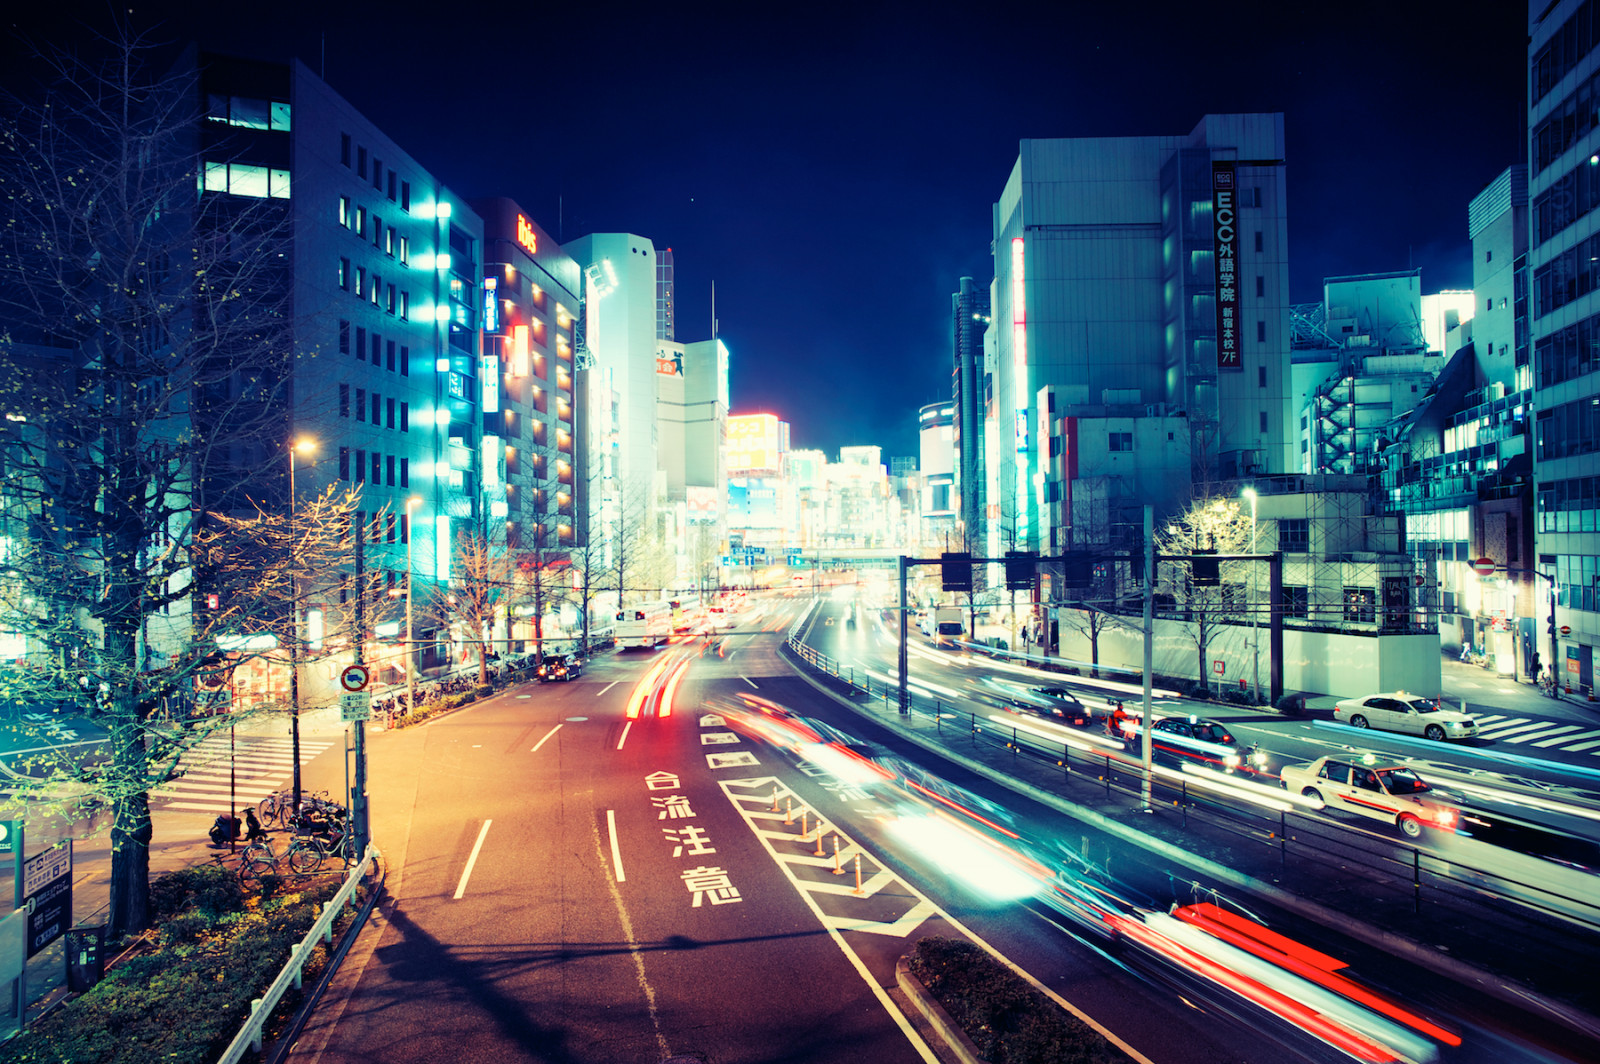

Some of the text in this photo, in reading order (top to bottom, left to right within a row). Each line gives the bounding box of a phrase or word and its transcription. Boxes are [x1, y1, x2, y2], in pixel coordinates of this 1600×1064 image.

[517, 213, 537, 254] ibis
[1217, 192, 1235, 302] ECC外語学院
[1223, 307, 1235, 350] 新宿本校
[1222, 351, 1236, 363] 7F
[645, 771, 743, 908] 合流注意
